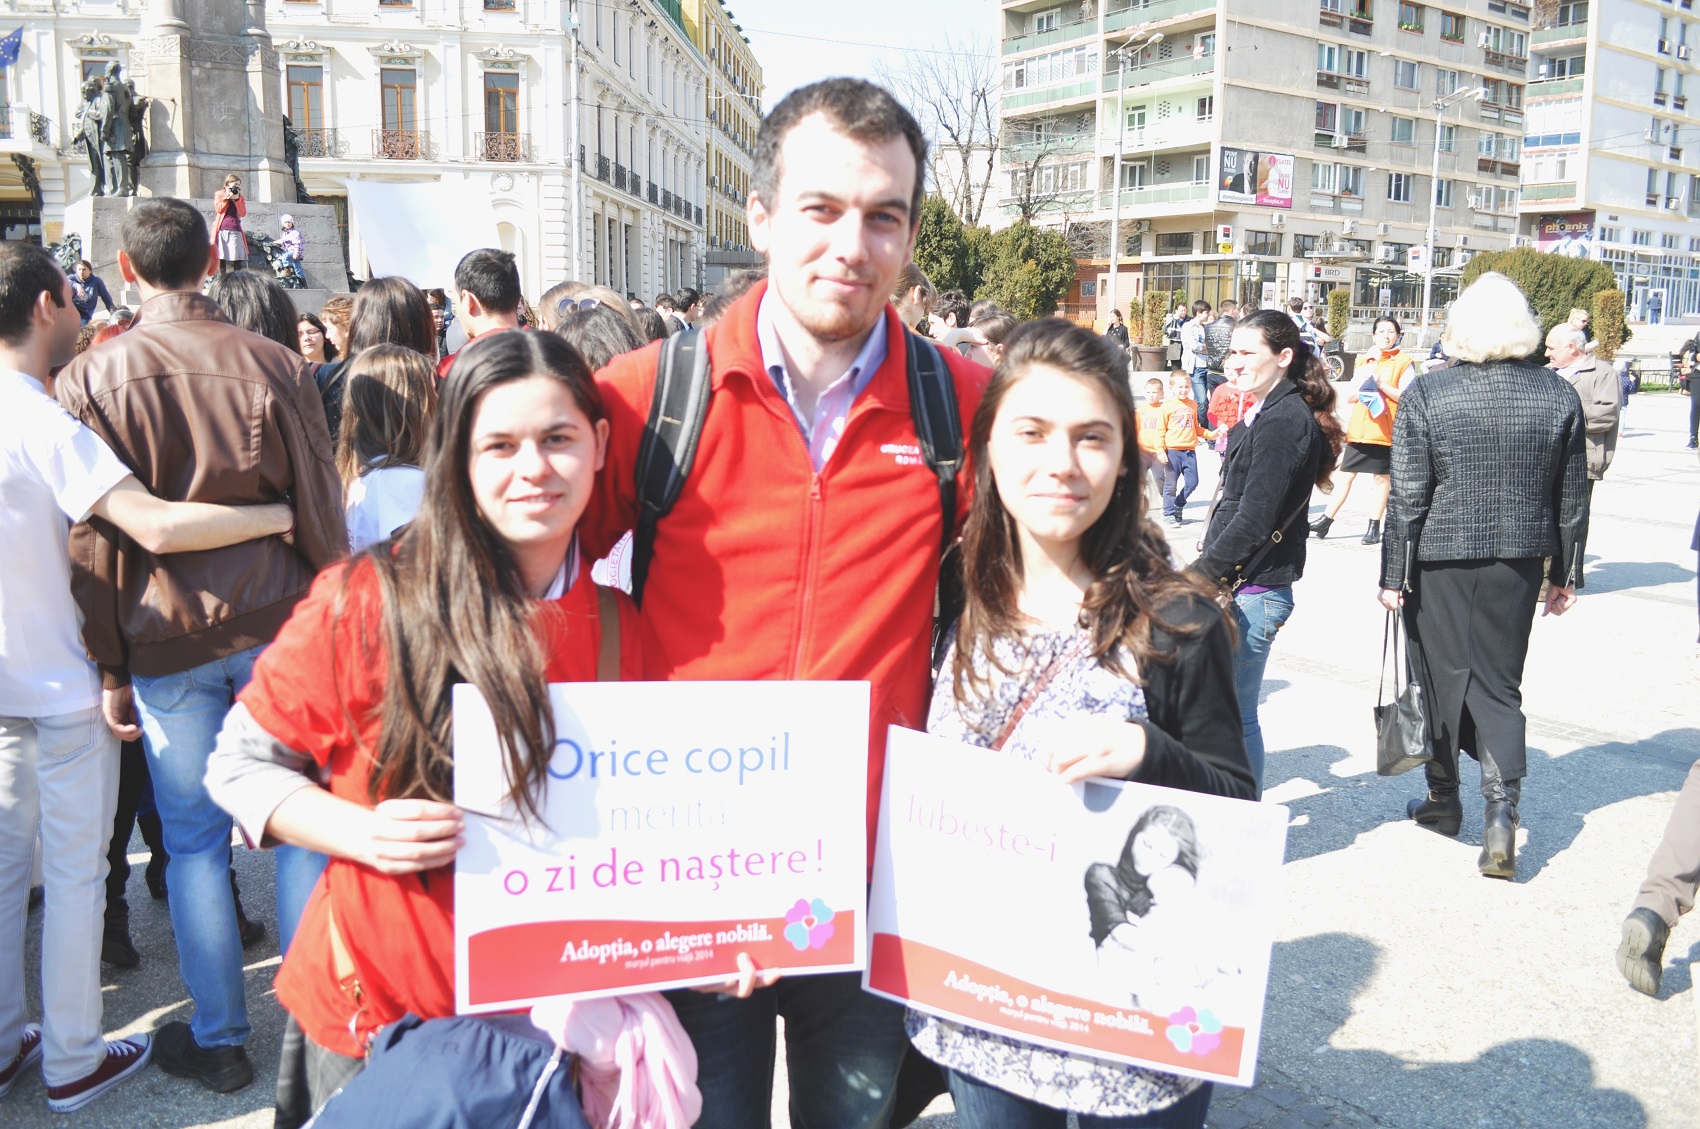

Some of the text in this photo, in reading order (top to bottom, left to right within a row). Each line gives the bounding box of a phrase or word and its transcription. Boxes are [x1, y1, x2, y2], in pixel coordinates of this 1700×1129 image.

[1224, 156, 1237, 169] NU
[1277, 178, 1290, 190] NU
[1324, 268, 1341, 277] BRD
[547, 731, 790, 786] Orice copil
[503, 869, 529, 896] o
[544, 854, 576, 893] zi
[592, 847, 645, 888] de
[640, 938, 654, 954] o
[655, 930, 714, 955] alegere
[694, 948, 714, 961] 2014
[1015, 993, 1029, 1009] o
[1030, 994, 1091, 1023] alegere
